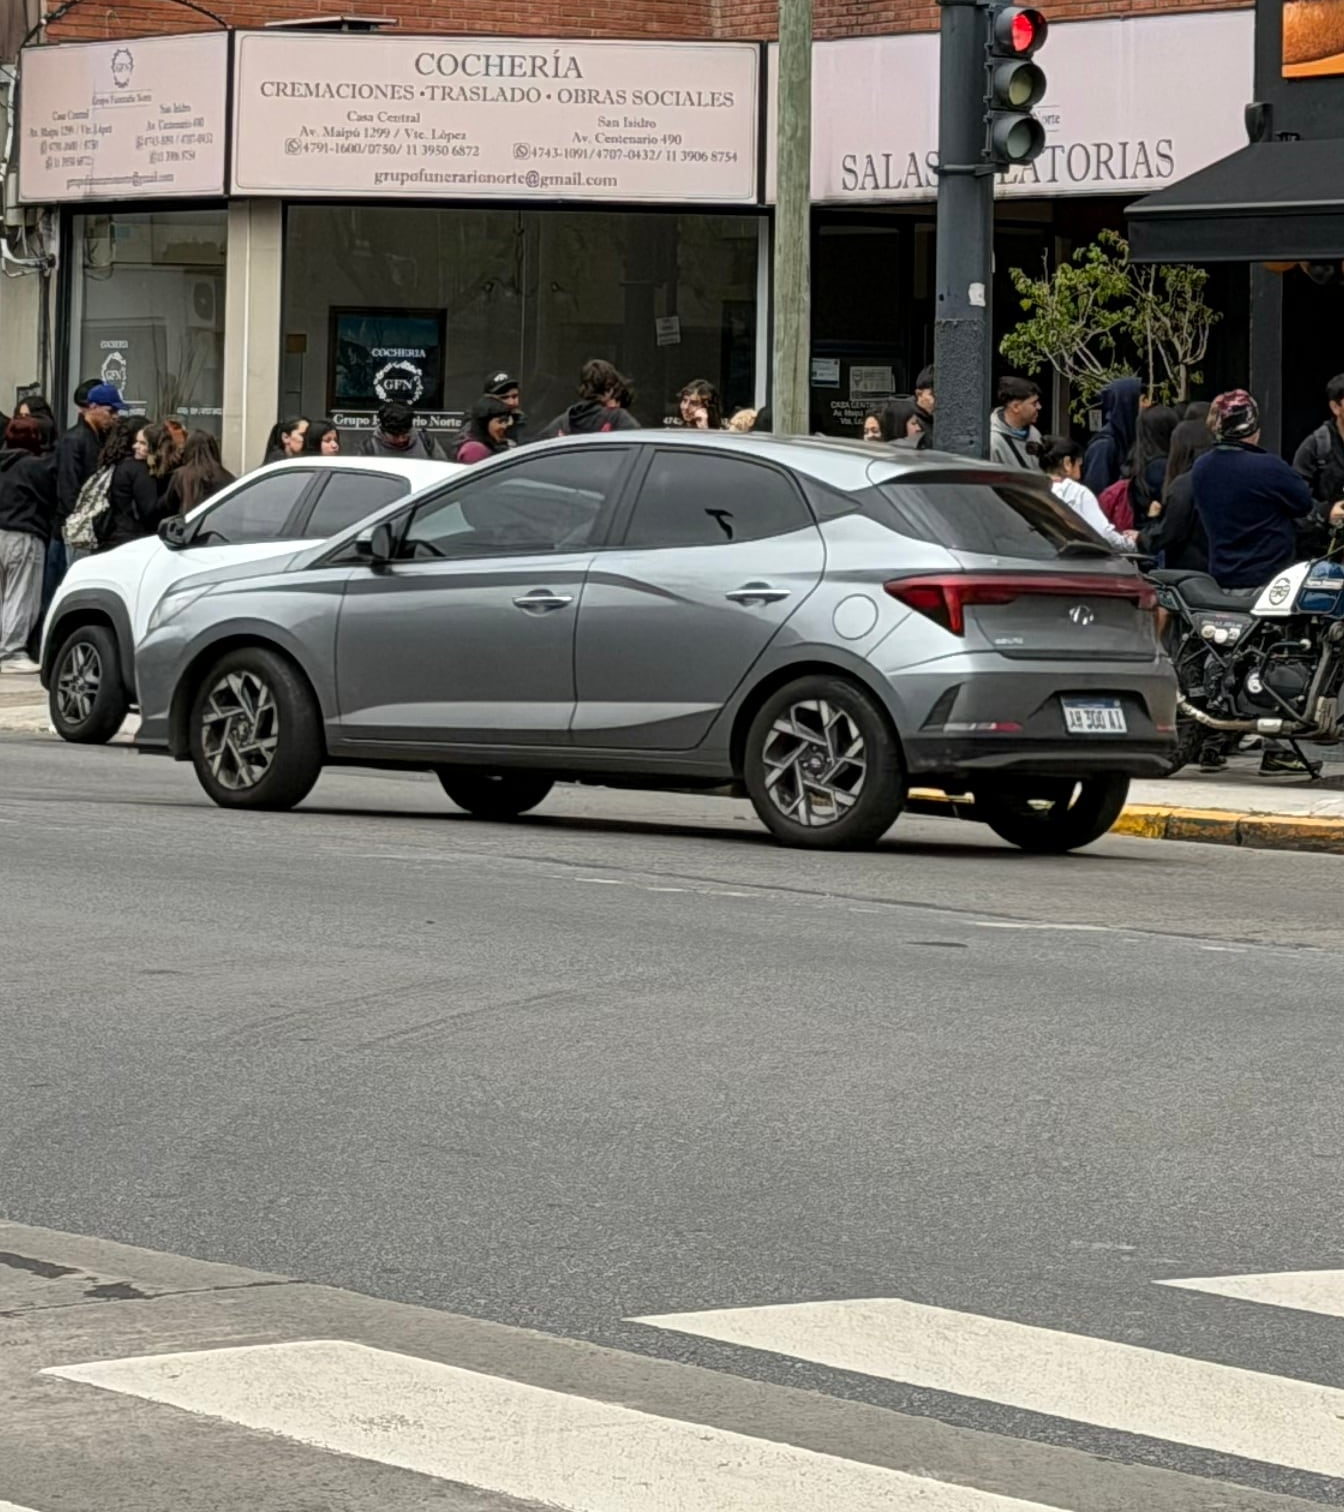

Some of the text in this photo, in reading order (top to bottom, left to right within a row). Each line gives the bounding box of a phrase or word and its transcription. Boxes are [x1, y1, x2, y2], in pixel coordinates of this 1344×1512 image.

[415, 49, 583, 79] COCHERÍA
[260, 81, 734, 107] CREMACIONES TRASLADO OBRAS SOCIALES
[347, 111, 421, 124] Casa Central
[598, 116, 656, 129] San Isidro
[364, 127, 391, 138] 1299
[572, 132, 682, 145] Av. Centenario 490
[451, 145, 480, 156] 6872
[680, 150, 709, 162] 3906
[711, 151, 737, 163] 8754
[842, 151, 940, 191] SALAS
[374, 169, 618, 188] grupofunerarionorte@gmail.com
[371, 348, 427, 359] COCHERIA
[383, 379, 413, 390] GFN
[333, 414, 370, 428] Grupo
[429, 415, 462, 427] Norte
